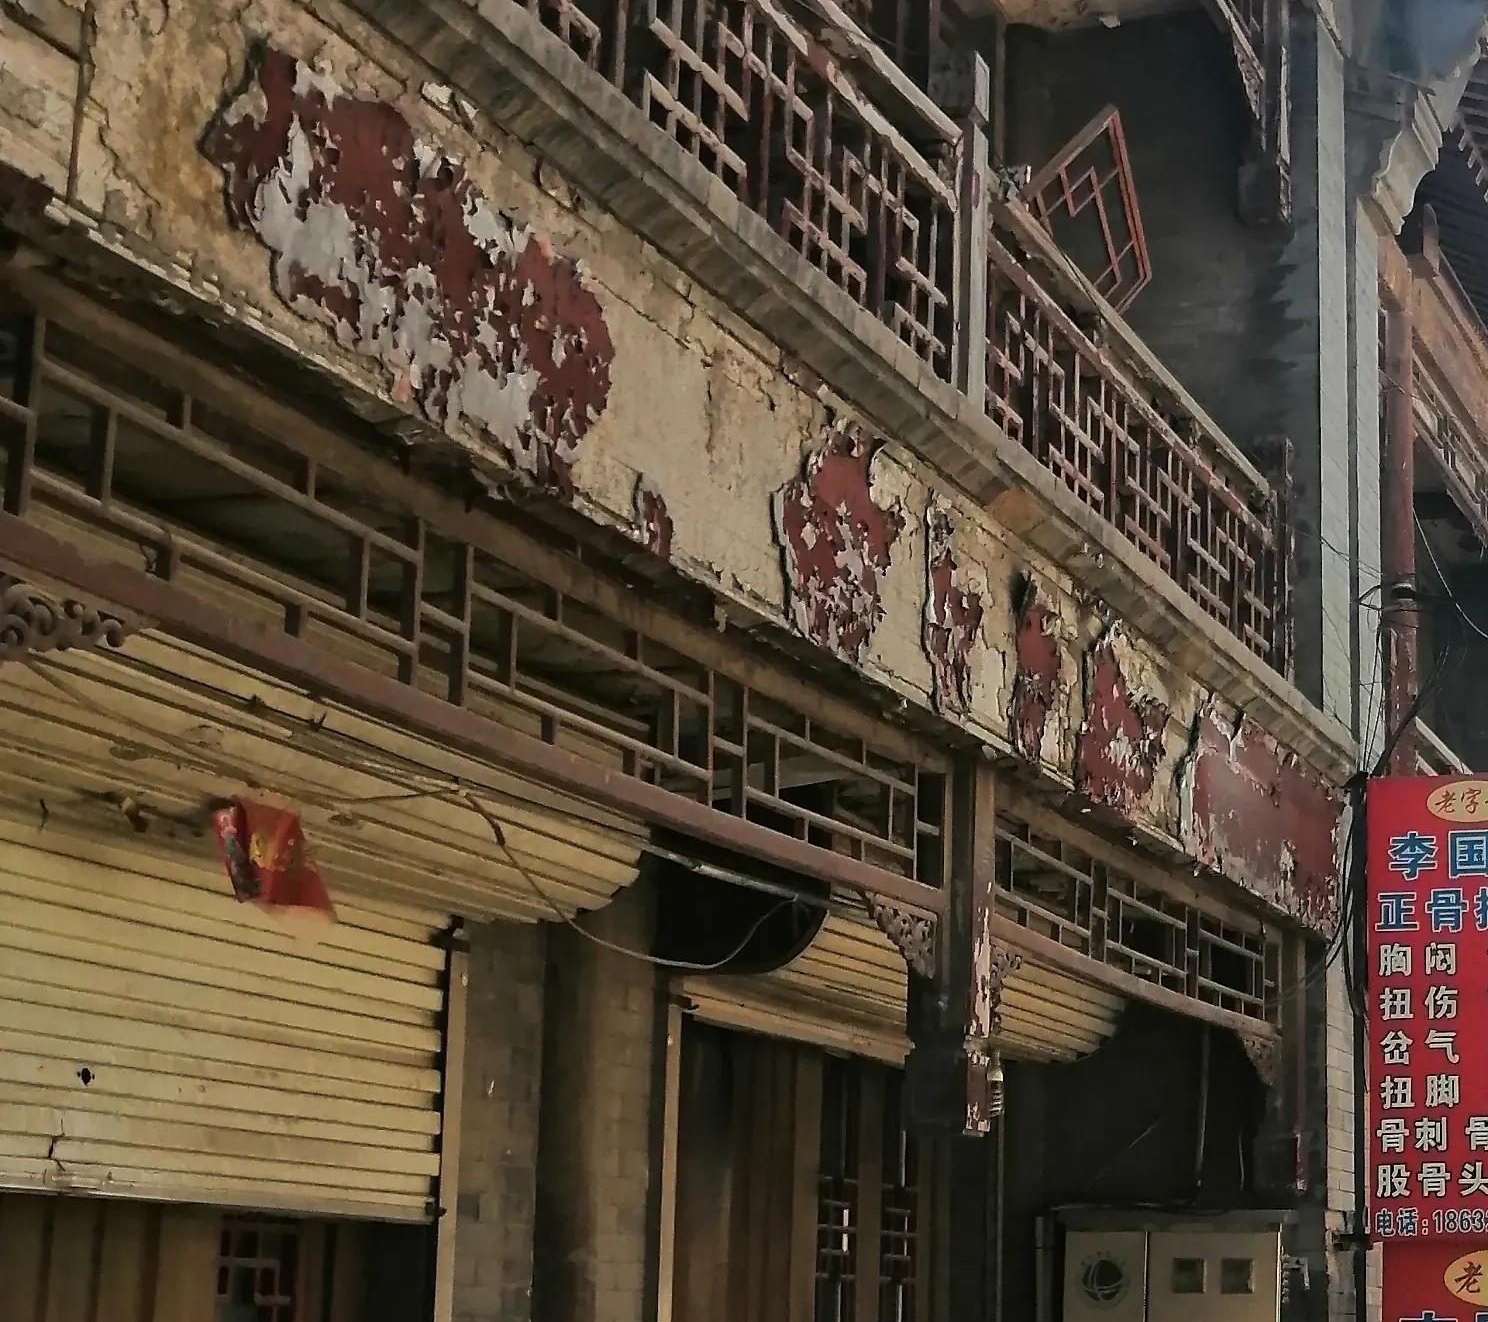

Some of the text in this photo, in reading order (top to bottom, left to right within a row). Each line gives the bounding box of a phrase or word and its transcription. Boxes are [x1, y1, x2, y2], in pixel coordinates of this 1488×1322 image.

[1379, 942, 1457, 977] 胸闷
[1380, 985, 1459, 1021] 扭伤
[1380, 1029, 1460, 1066] 岔气
[1380, 1074, 1460, 1110] 扭脚
[1376, 1117, 1447, 1153] 骨刺
